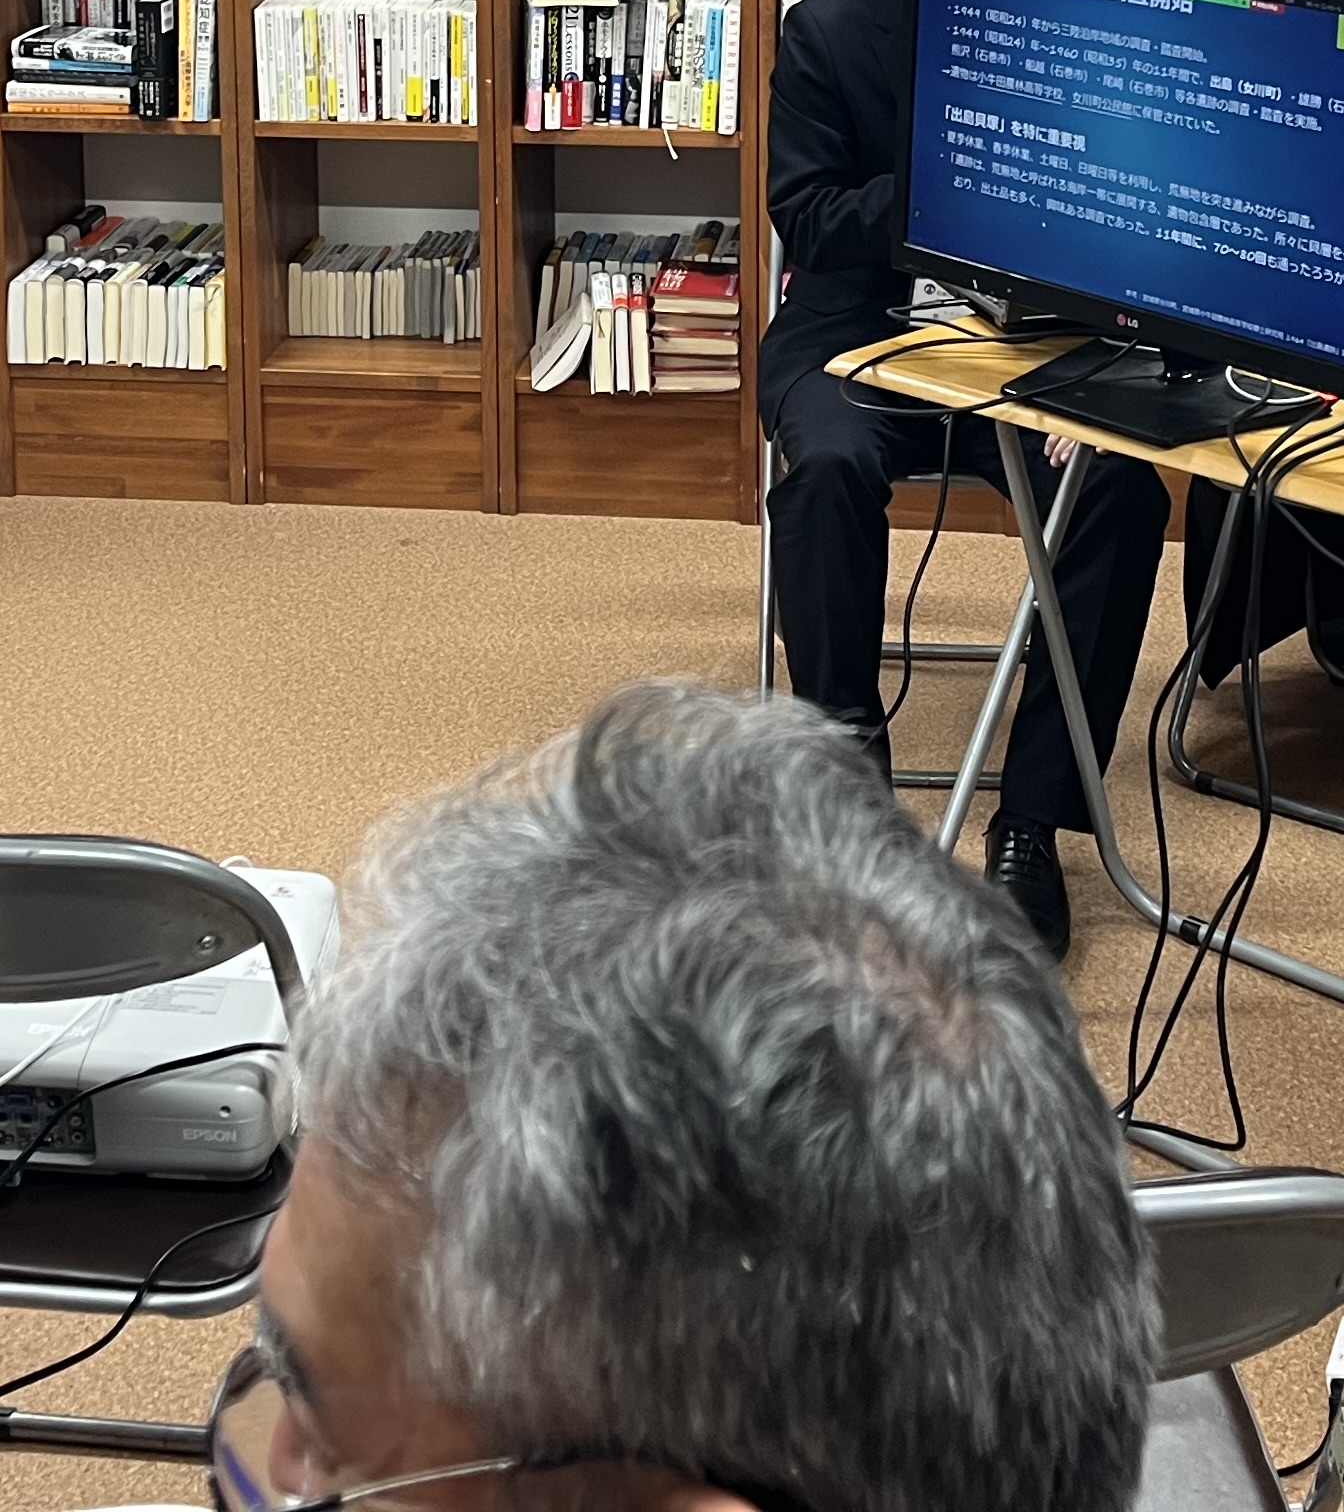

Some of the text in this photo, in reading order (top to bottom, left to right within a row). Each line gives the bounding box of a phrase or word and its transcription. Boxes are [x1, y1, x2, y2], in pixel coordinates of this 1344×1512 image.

[564, 23, 577, 72] Lessons
[723, 9, 739, 131] ANTHRO VISION
[945, 104, 1087, 153] 「出島貝塚」を特に重要視
[1127, 318, 1139, 329] LG
[182, 1128, 238, 1144] EPSON
